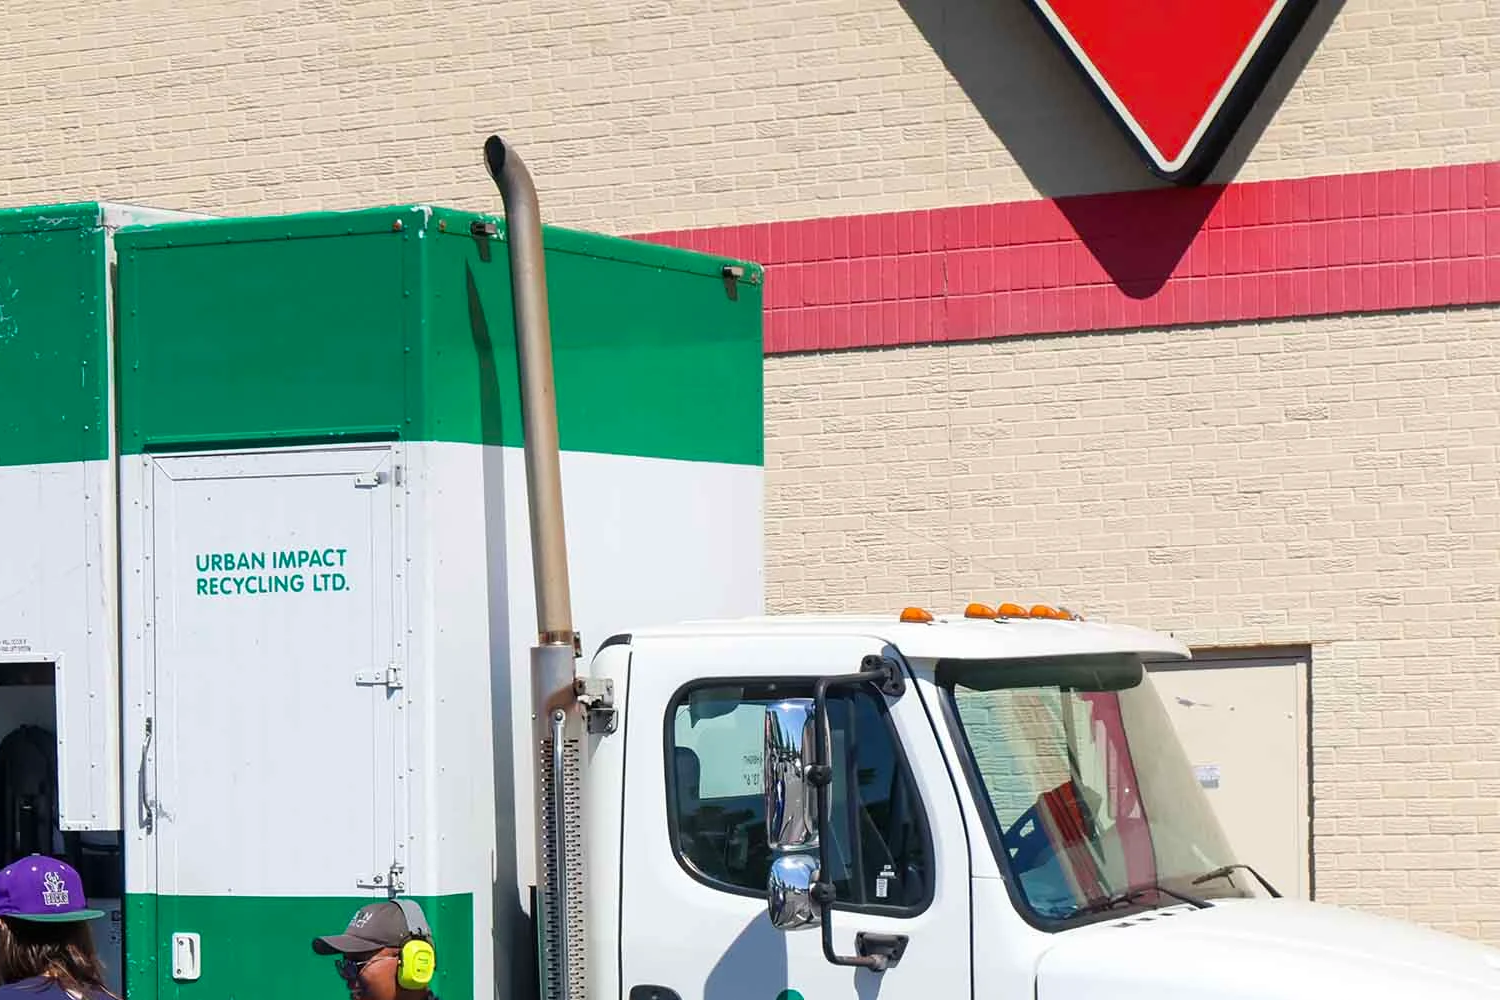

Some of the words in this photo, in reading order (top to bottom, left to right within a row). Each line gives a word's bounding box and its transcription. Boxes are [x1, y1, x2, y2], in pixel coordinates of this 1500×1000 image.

[196, 552, 265, 572] URBAN
[272, 549, 347, 569] IMPACT
[196, 575, 305, 595] RECYCLING
[313, 573, 350, 591] LTD.
